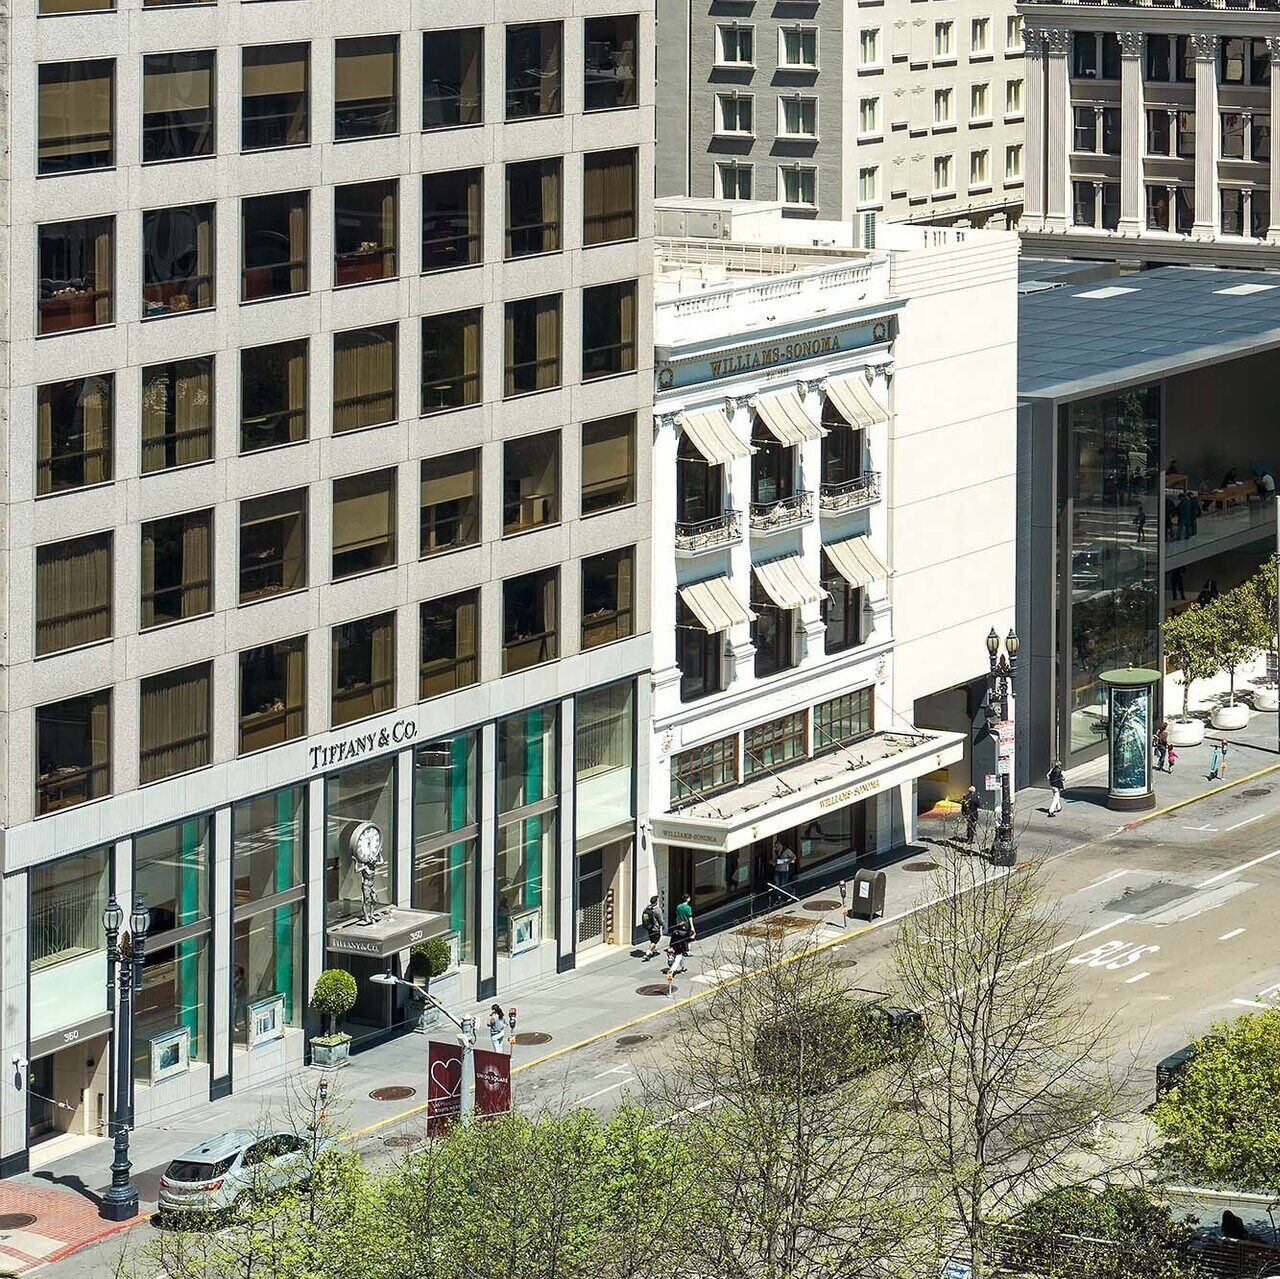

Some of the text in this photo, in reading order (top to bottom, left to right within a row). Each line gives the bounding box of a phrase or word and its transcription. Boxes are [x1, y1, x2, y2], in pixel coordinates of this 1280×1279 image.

[709, 334, 841, 377] WILLIAMS-SONOMA
[308, 732, 377, 770] TIFFANY
[377, 727, 391, 748] &
[818, 779, 882, 810] WILLIAMS-SONOMA
[661, 829, 718, 843] WILLIAMS-SONOMA
[409, 930, 423, 941] 350
[1065, 939, 1161, 970] BUS
